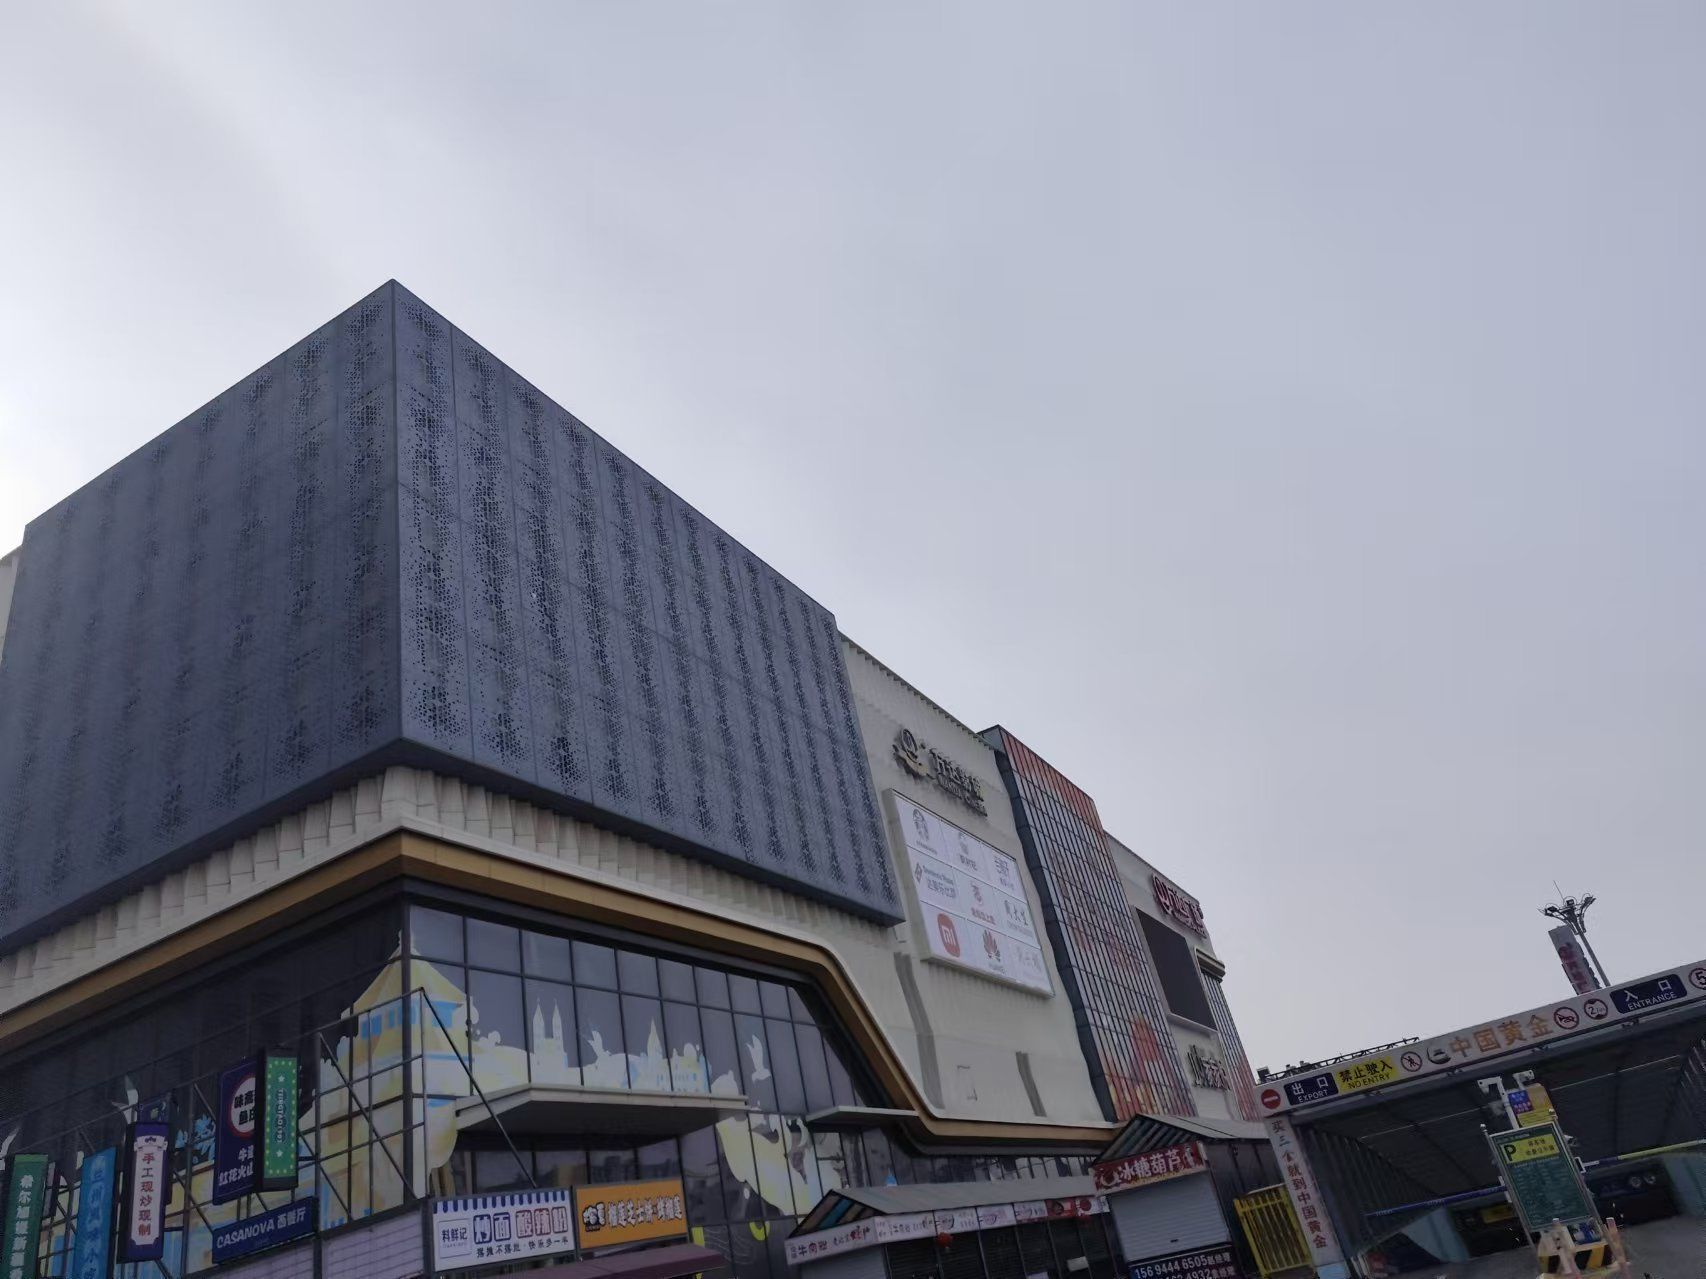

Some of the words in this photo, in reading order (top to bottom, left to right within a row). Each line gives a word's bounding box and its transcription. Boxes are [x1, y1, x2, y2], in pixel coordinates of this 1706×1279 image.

[1624, 979, 1672, 1001] 入口
[1628, 991, 1677, 1010] ENTRANCE
[1448, 1014, 1553, 1058] 中国黄金
[1338, 1060, 1393, 1083] 禁止驶入
[1362, 1073, 1391, 1087] ENTRY
[1291, 1075, 1329, 1096] 出口
[1297, 1088, 1329, 1104] EXPORT
[1504, 1144, 1517, 1161] P
[1117, 1149, 1182, 1181] 冰糖葫芦
[138, 1153, 155, 1237] 手工现炒现制
[1271, 1120, 1328, 1249] 买三金就到中国黄金
[216, 1218, 275, 1249] CASANOVA
[277, 1207, 306, 1229] 西餐厅
[474, 1212, 511, 1244] 炒面
[516, 1207, 568, 1238] 酸辣粉
[1135, 1266, 1153, 1279] 156
[1155, 1261, 1180, 1275] 9444
